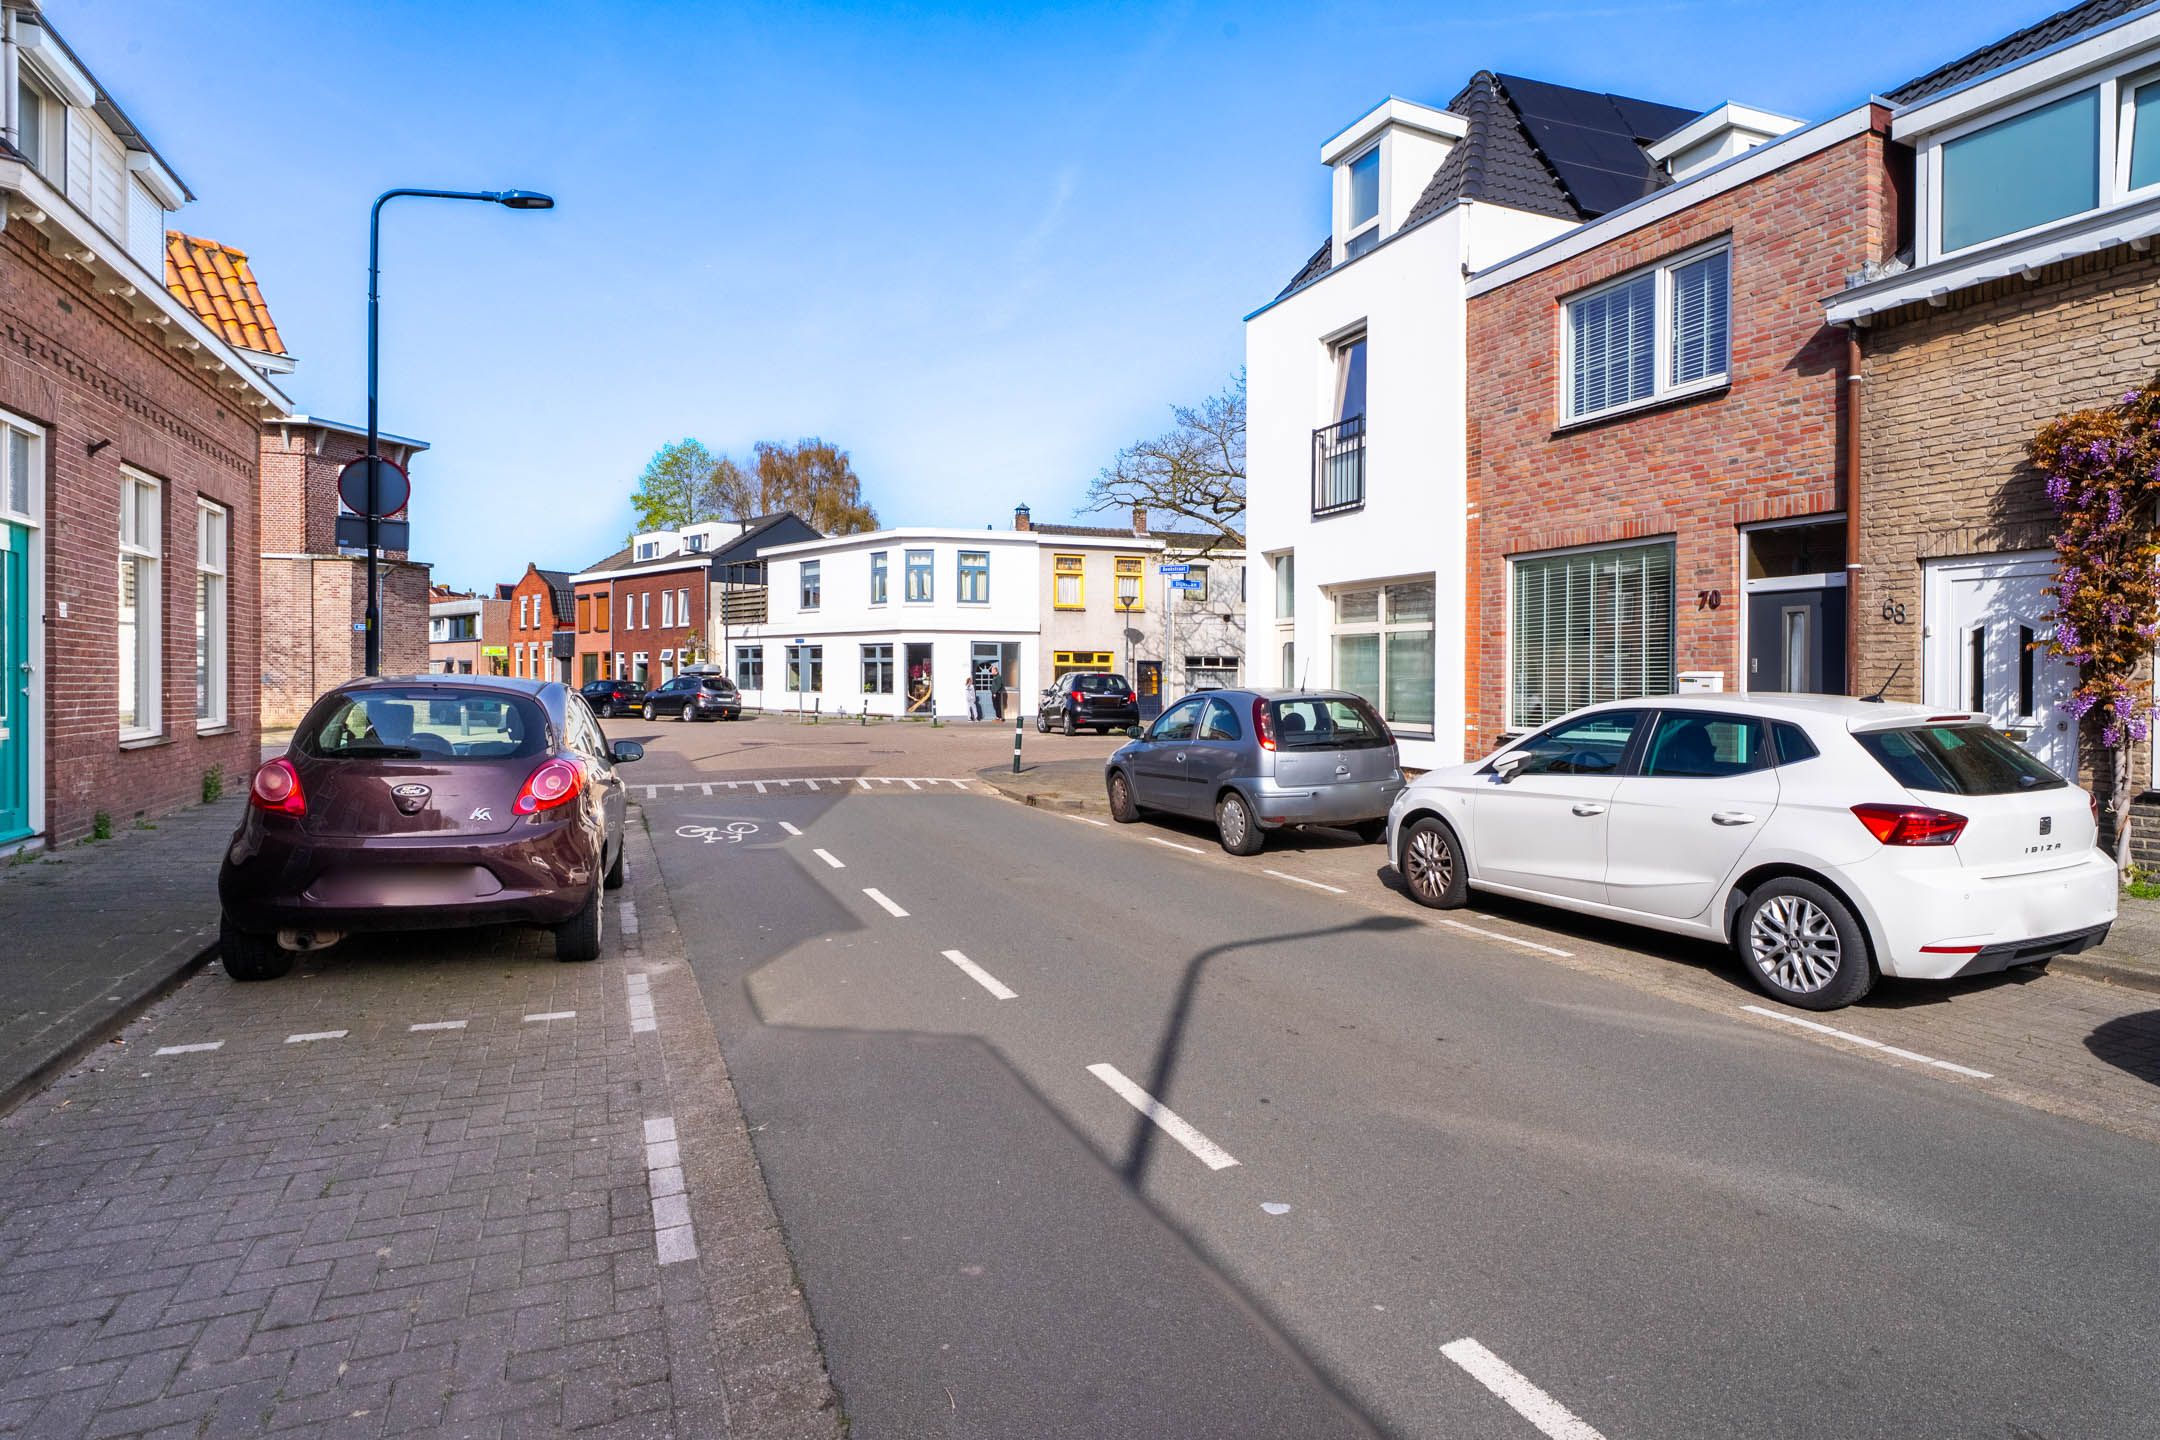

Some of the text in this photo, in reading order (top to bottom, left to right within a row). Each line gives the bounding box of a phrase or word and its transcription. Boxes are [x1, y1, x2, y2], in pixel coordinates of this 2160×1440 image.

[1698, 590, 1721, 611] 70
[1882, 598, 1905, 625] 68
[2025, 843, 2061, 853] IBIZA
